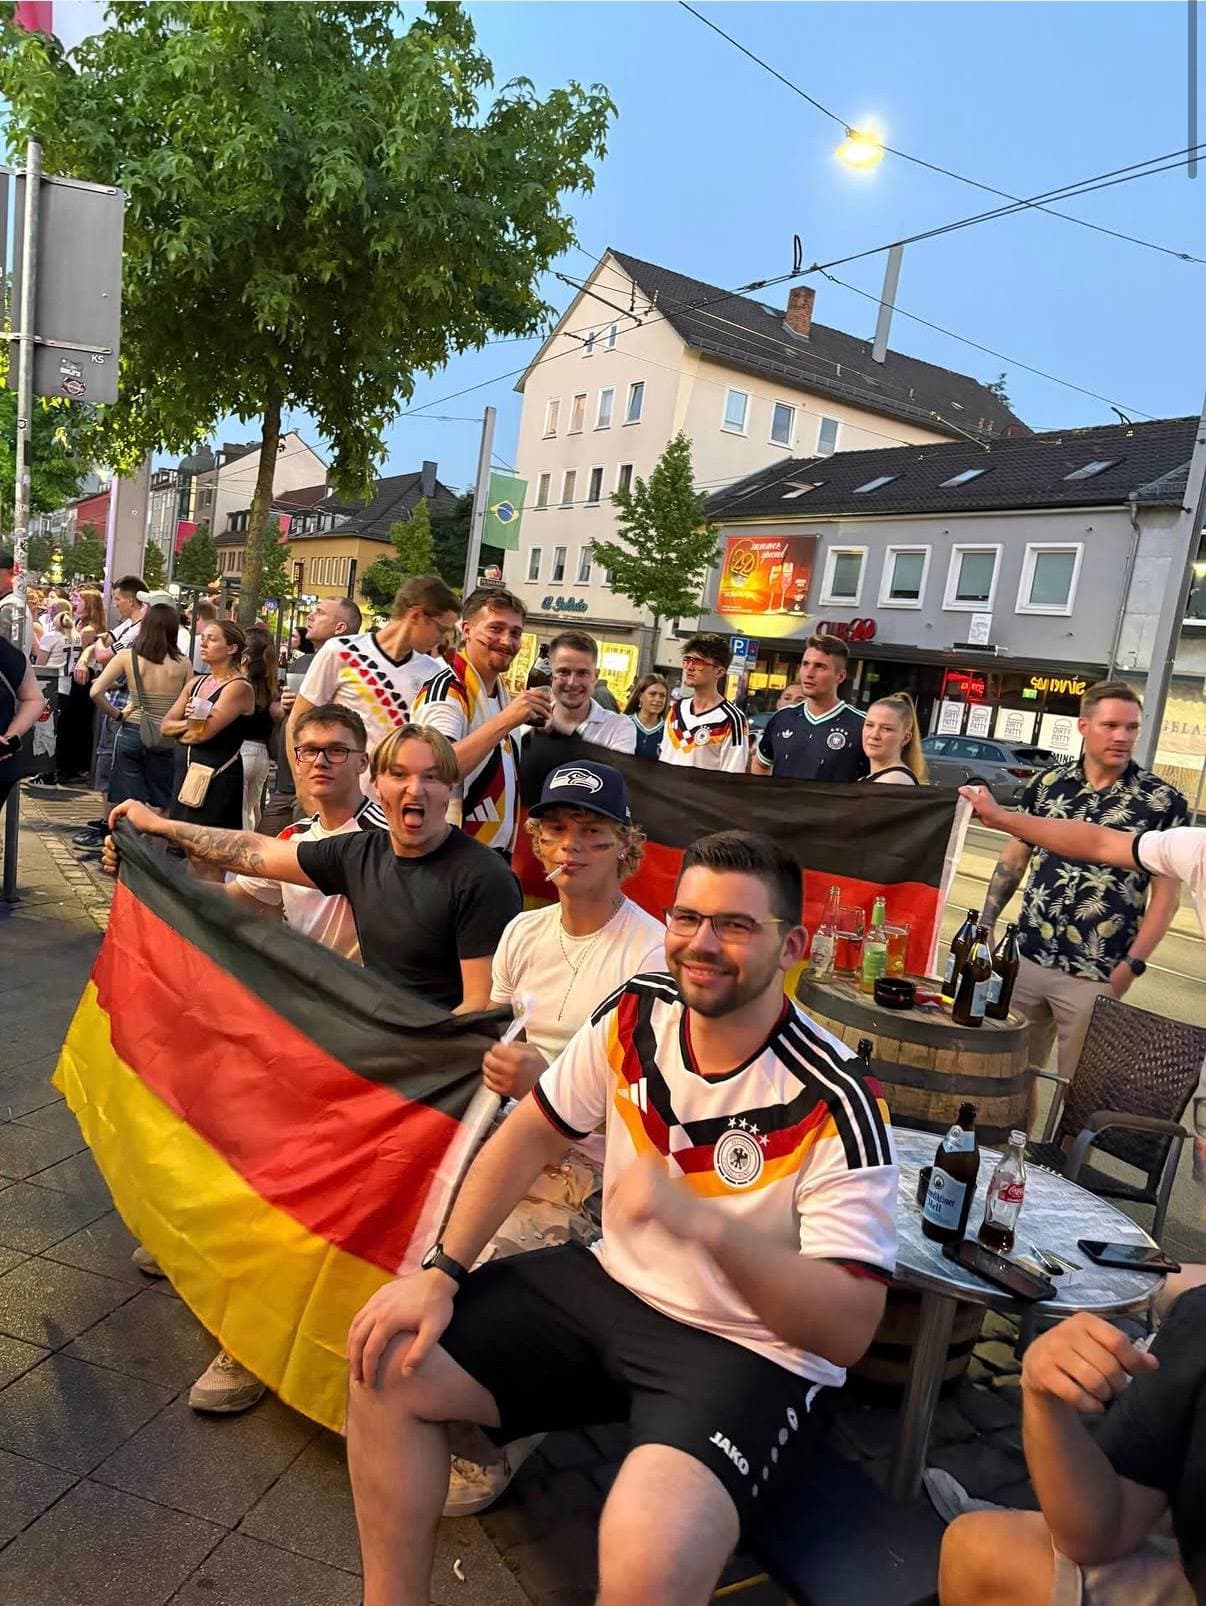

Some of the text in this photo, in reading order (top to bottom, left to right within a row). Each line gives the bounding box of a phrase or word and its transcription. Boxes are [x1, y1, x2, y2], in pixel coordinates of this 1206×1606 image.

[91, 354, 104, 363] KS
[734, 640, 744, 654] P
[709, 1431, 749, 1475] JAKO
